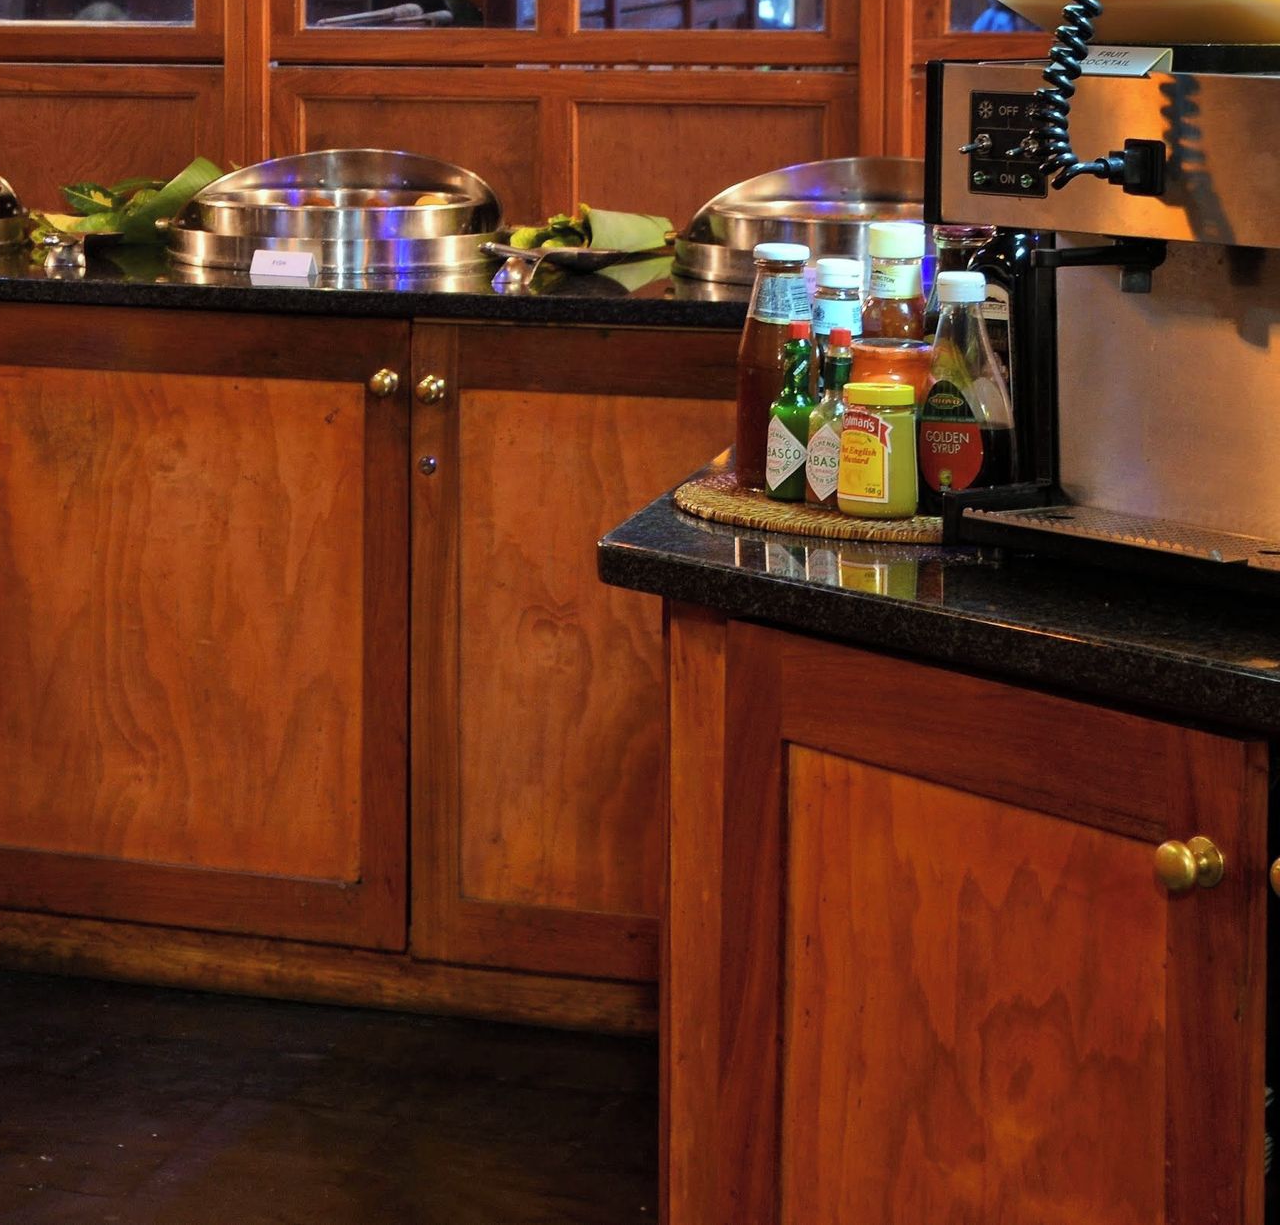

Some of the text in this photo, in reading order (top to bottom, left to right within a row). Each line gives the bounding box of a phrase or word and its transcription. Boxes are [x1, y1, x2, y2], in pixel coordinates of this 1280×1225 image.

[1098, 51, 1129, 59] FRUIT
[999, 106, 1019, 116] OFF
[1000, 174, 1015, 184] ON
[843, 416, 875, 433] Colman's
[925, 430, 970, 444] GOLDEN
[849, 446, 877, 457] English
[931, 442, 961, 454] SYRUP
[808, 455, 840, 469] ABAS
